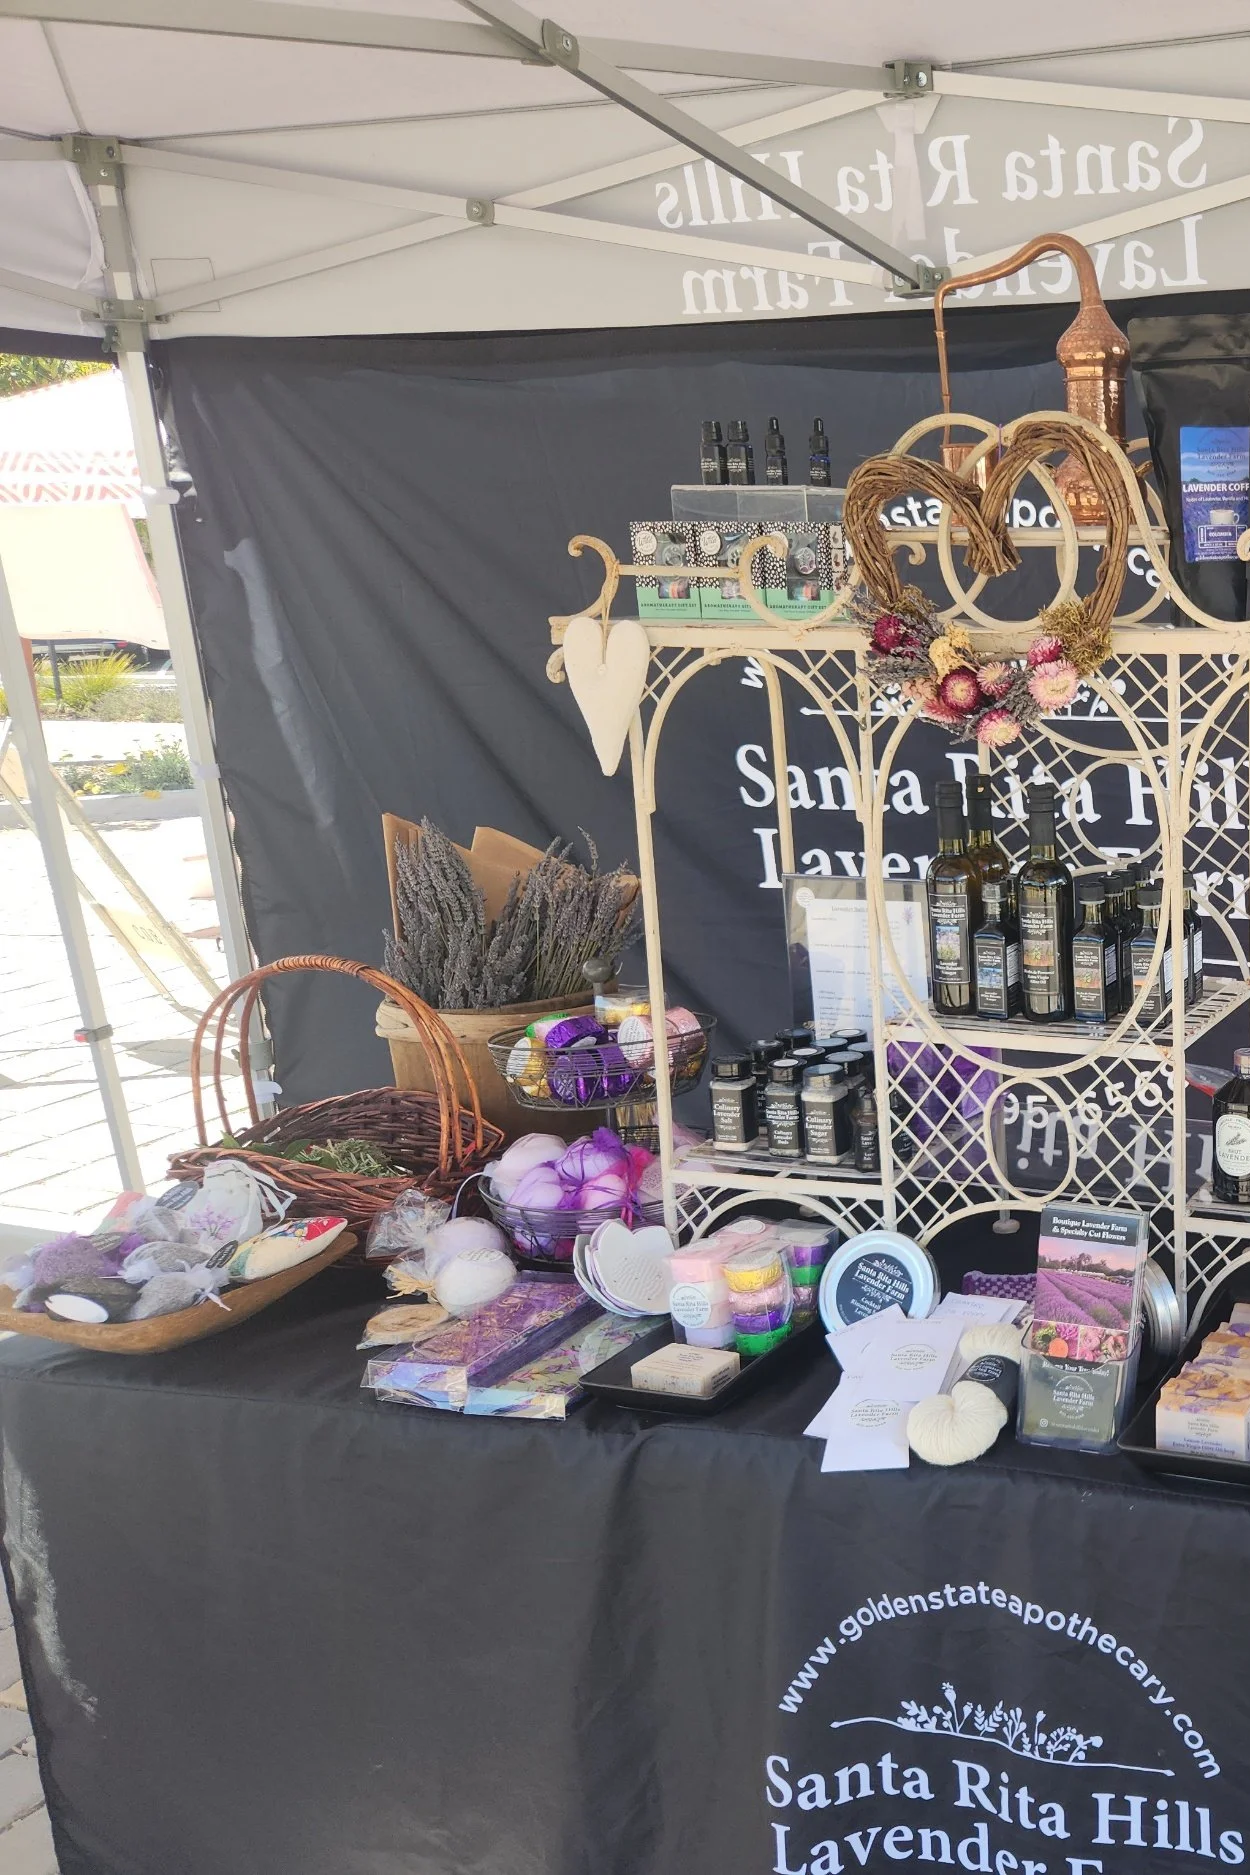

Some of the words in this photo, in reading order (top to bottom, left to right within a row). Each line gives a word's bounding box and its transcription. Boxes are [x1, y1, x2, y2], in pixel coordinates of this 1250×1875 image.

[1183, 482, 1227, 492] LAVENDER
[713, 1103, 741, 1112] Culinary
[713, 1109, 741, 1118] Lavender
[805, 1123, 833, 1131] Lavender
[806, 1116, 833, 1125] Culinary
[810, 1129, 828, 1138] Sugar
[1052, 1216, 1081, 1228] Boutique
[1081, 1219, 1111, 1232] Lavender
[1110, 1223, 1128, 1233] Farm
[1060, 1226, 1088, 1238] Specialty
[1088, 1229, 1102, 1238] Cut
[1101, 1231, 1126, 1241] Flowers
[854, 1269, 887, 1290] Lavender
[885, 1285, 905, 1300] Farm
[857, 1262, 877, 1277] Santa
[877, 1271, 892, 1284] Rita
[892, 1279, 910, 1294] Hills
[861, 1296, 882, 1310] Cocktail
[778, 1581, 1222, 1779] www.goldenstateapothecary.com
[765, 1751, 935, 1811] Santa
[952, 1757, 1072, 1839] Rita
[1090, 1791, 1246, 1865] Hills
[770, 1821, 1048, 1875] Lavender
